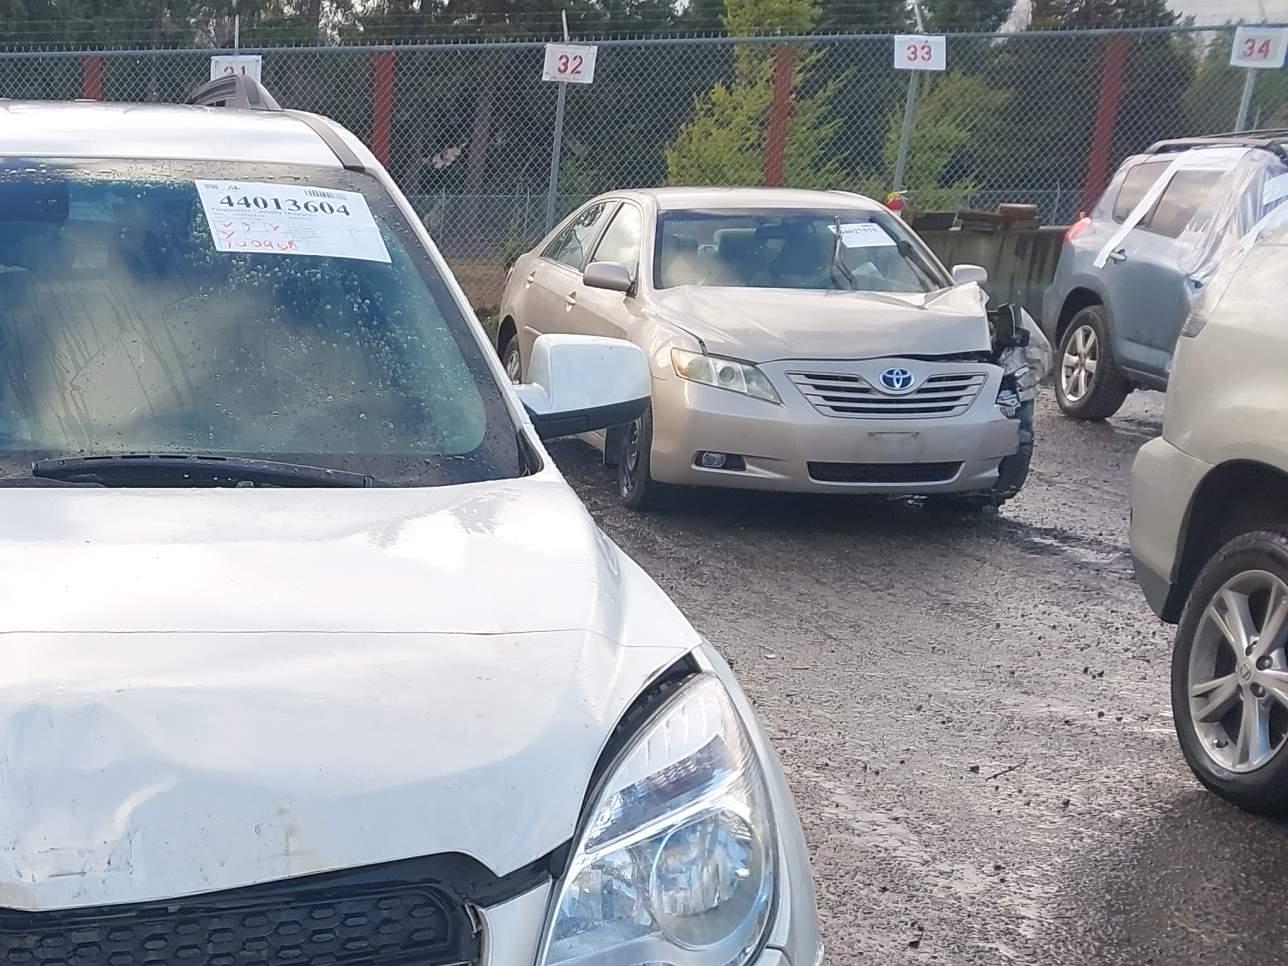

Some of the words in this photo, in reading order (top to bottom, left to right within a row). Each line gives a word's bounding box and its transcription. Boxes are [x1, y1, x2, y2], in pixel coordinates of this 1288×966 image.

[907, 45, 932, 61] 33
[1243, 38, 1271, 58] 34
[558, 54, 583, 74] 32
[220, 195, 351, 217] 44013604
